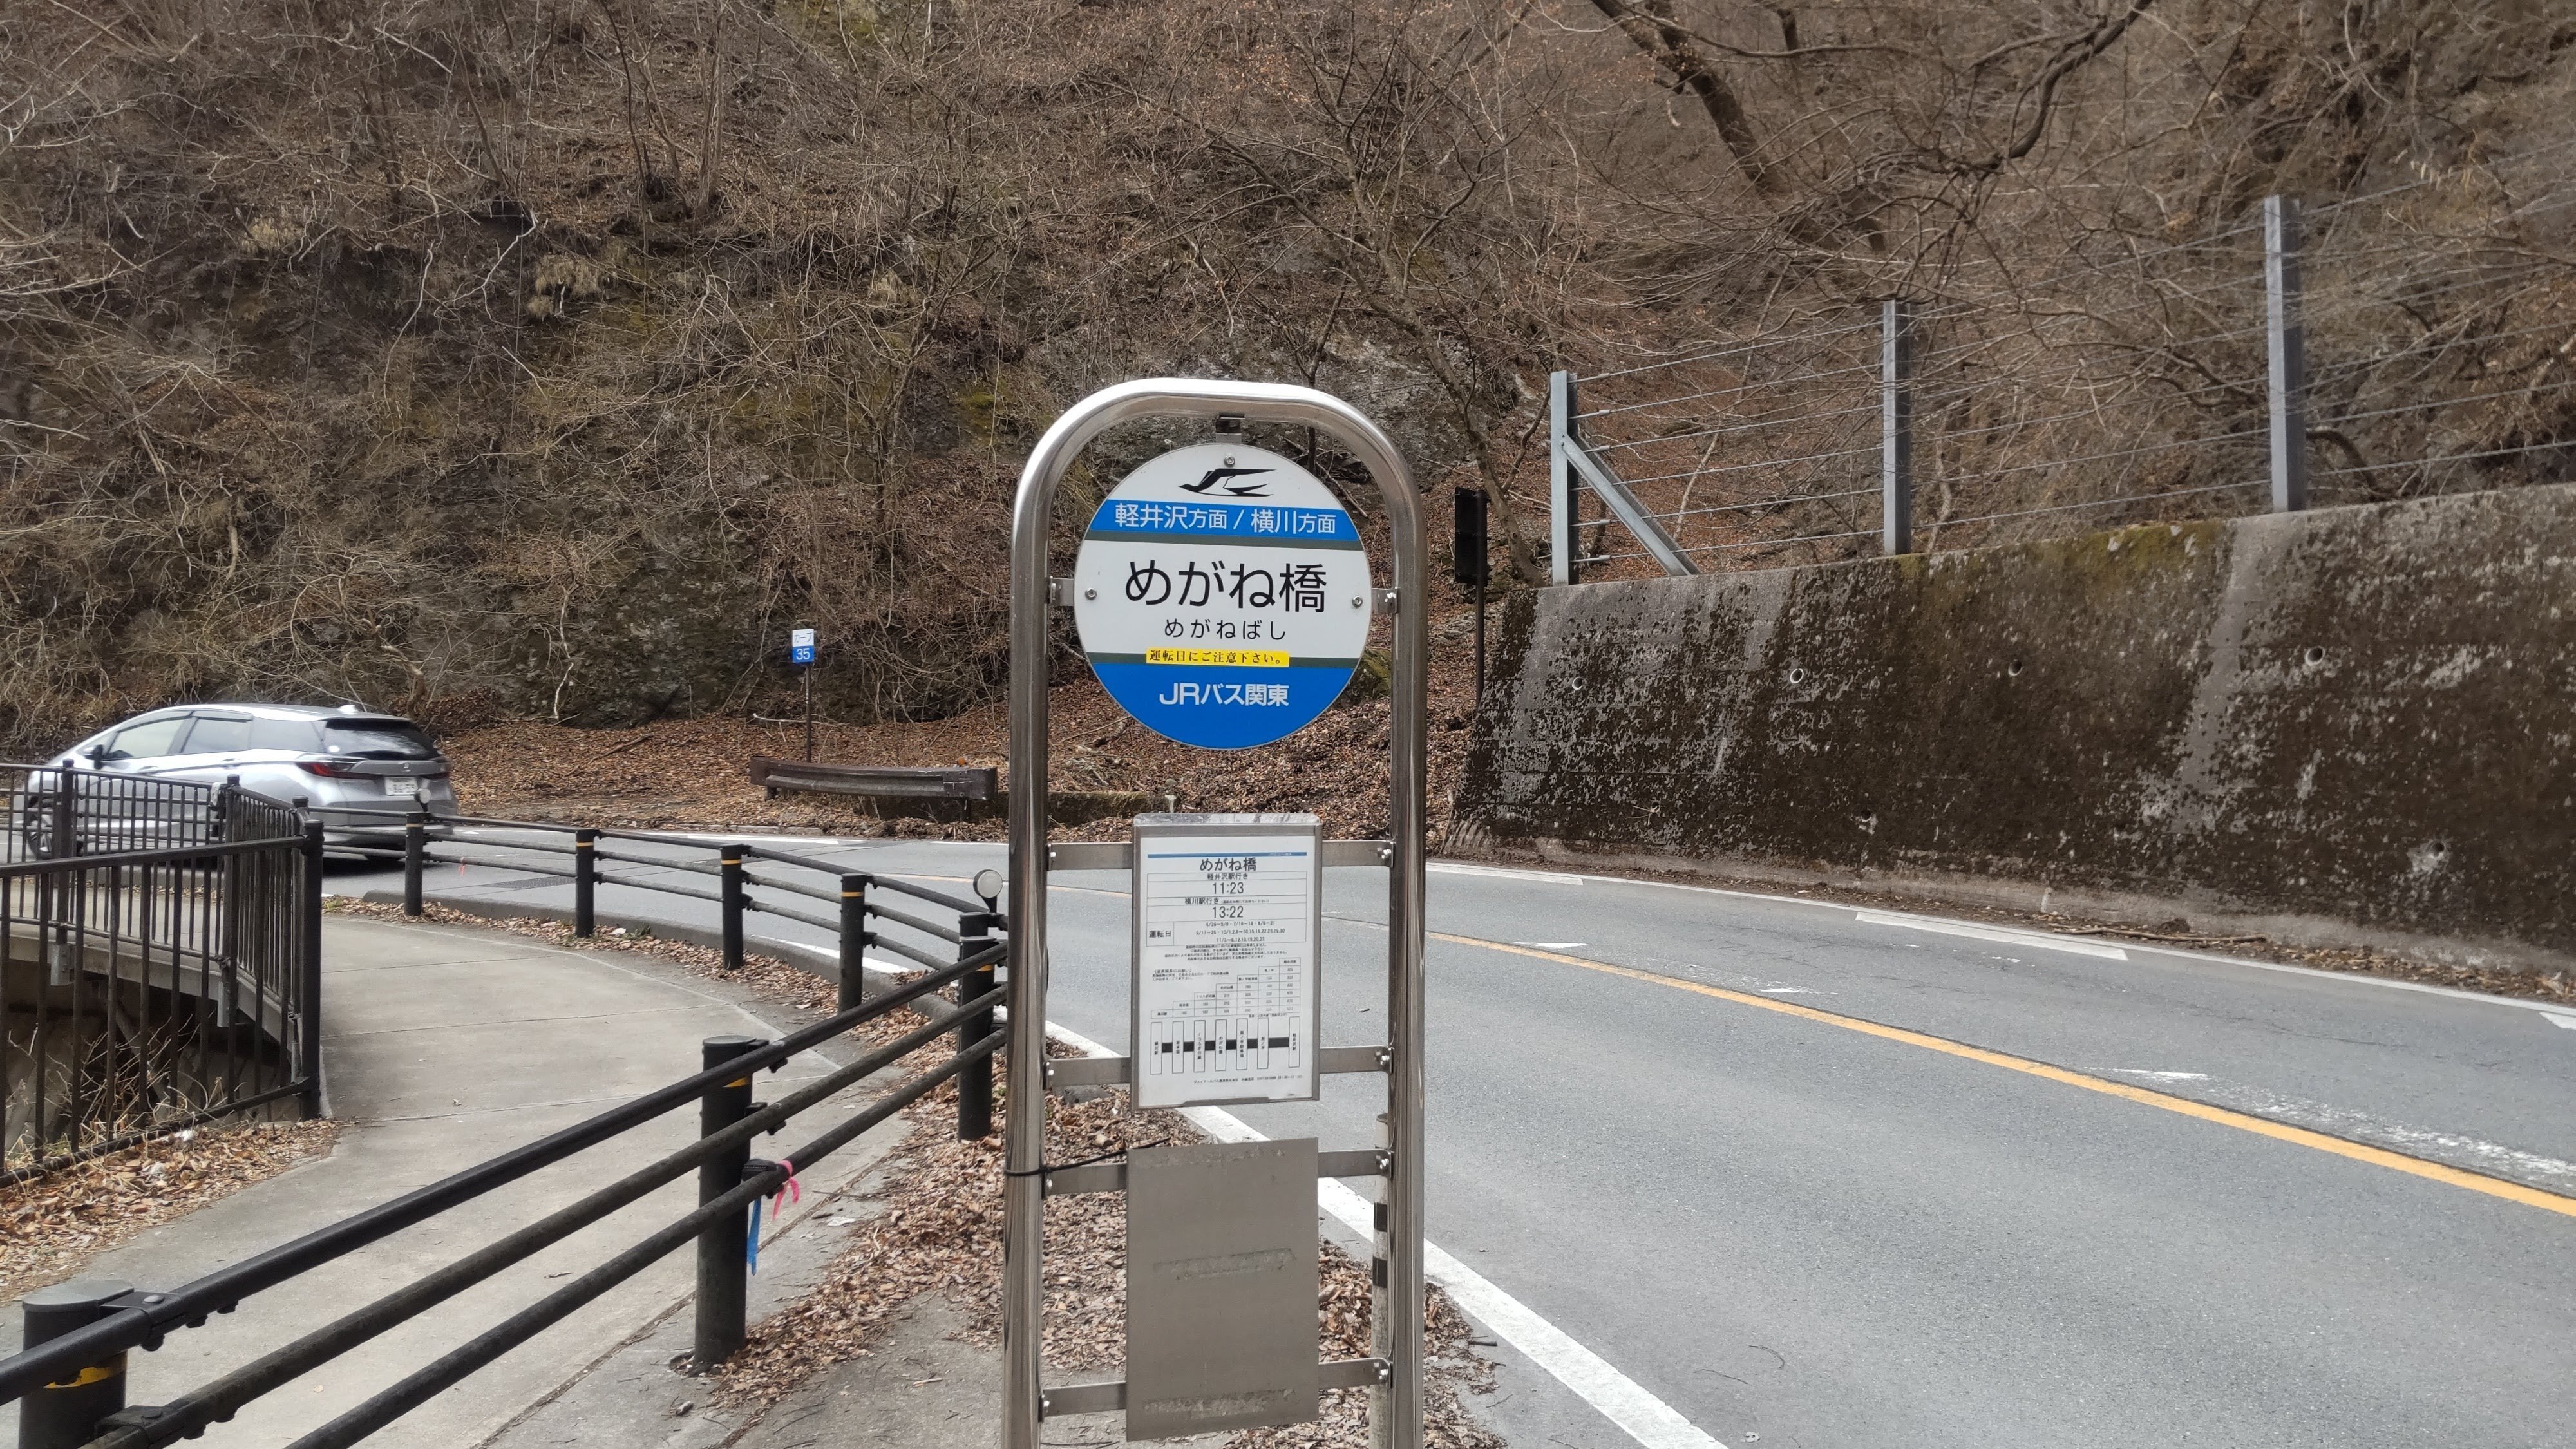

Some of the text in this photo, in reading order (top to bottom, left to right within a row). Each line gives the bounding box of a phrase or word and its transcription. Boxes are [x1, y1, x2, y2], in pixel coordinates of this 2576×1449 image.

[1115, 503, 1227, 529] 軽井沢方面
[1251, 509, 1336, 534] 横川方面
[1125, 559, 1327, 612] めがね橋
[1164, 618, 1286, 639] めがねばし
[797, 648, 810, 660] 35
[1150, 649, 1280, 664] 運転日にご注意下さい。
[1160, 683, 1289, 706] JRバス関東
[1200, 857, 1256, 871] めがね橋
[1207, 872, 1248, 880] 軽井沢駅行き
[1213, 882, 1244, 894] 11:23
[1185, 896, 1219, 905] 横川駅行き
[1213, 905, 1244, 918] 13:22
